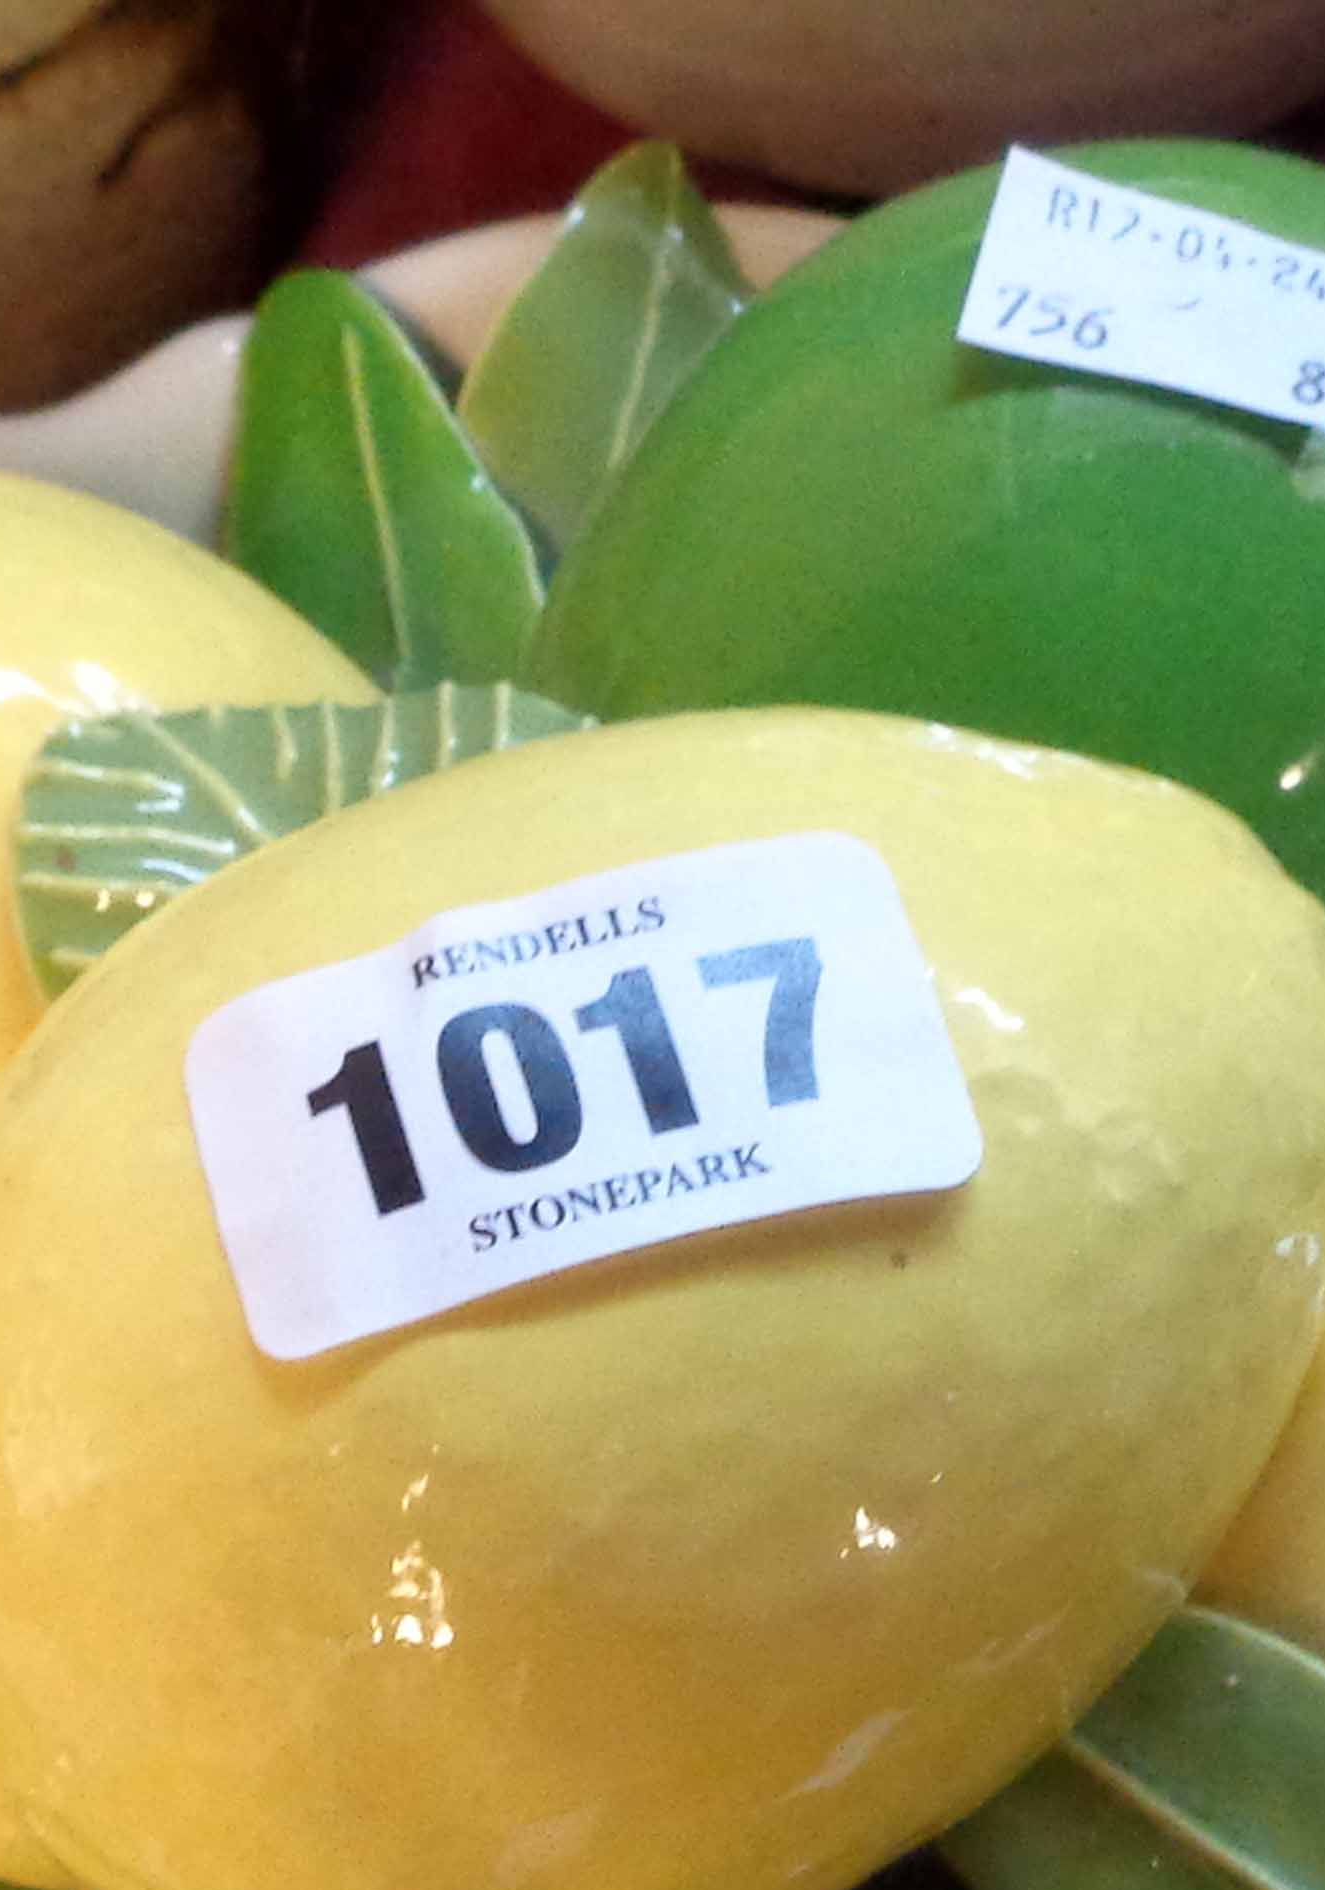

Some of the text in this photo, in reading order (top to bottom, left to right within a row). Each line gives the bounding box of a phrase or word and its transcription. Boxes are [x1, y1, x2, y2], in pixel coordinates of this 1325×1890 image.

[996, 285, 1114, 351] 756
[412, 896, 667, 991] RENDELLS
[305, 935, 825, 1218] 1017
[469, 1142, 772, 1253] STONEPARK
